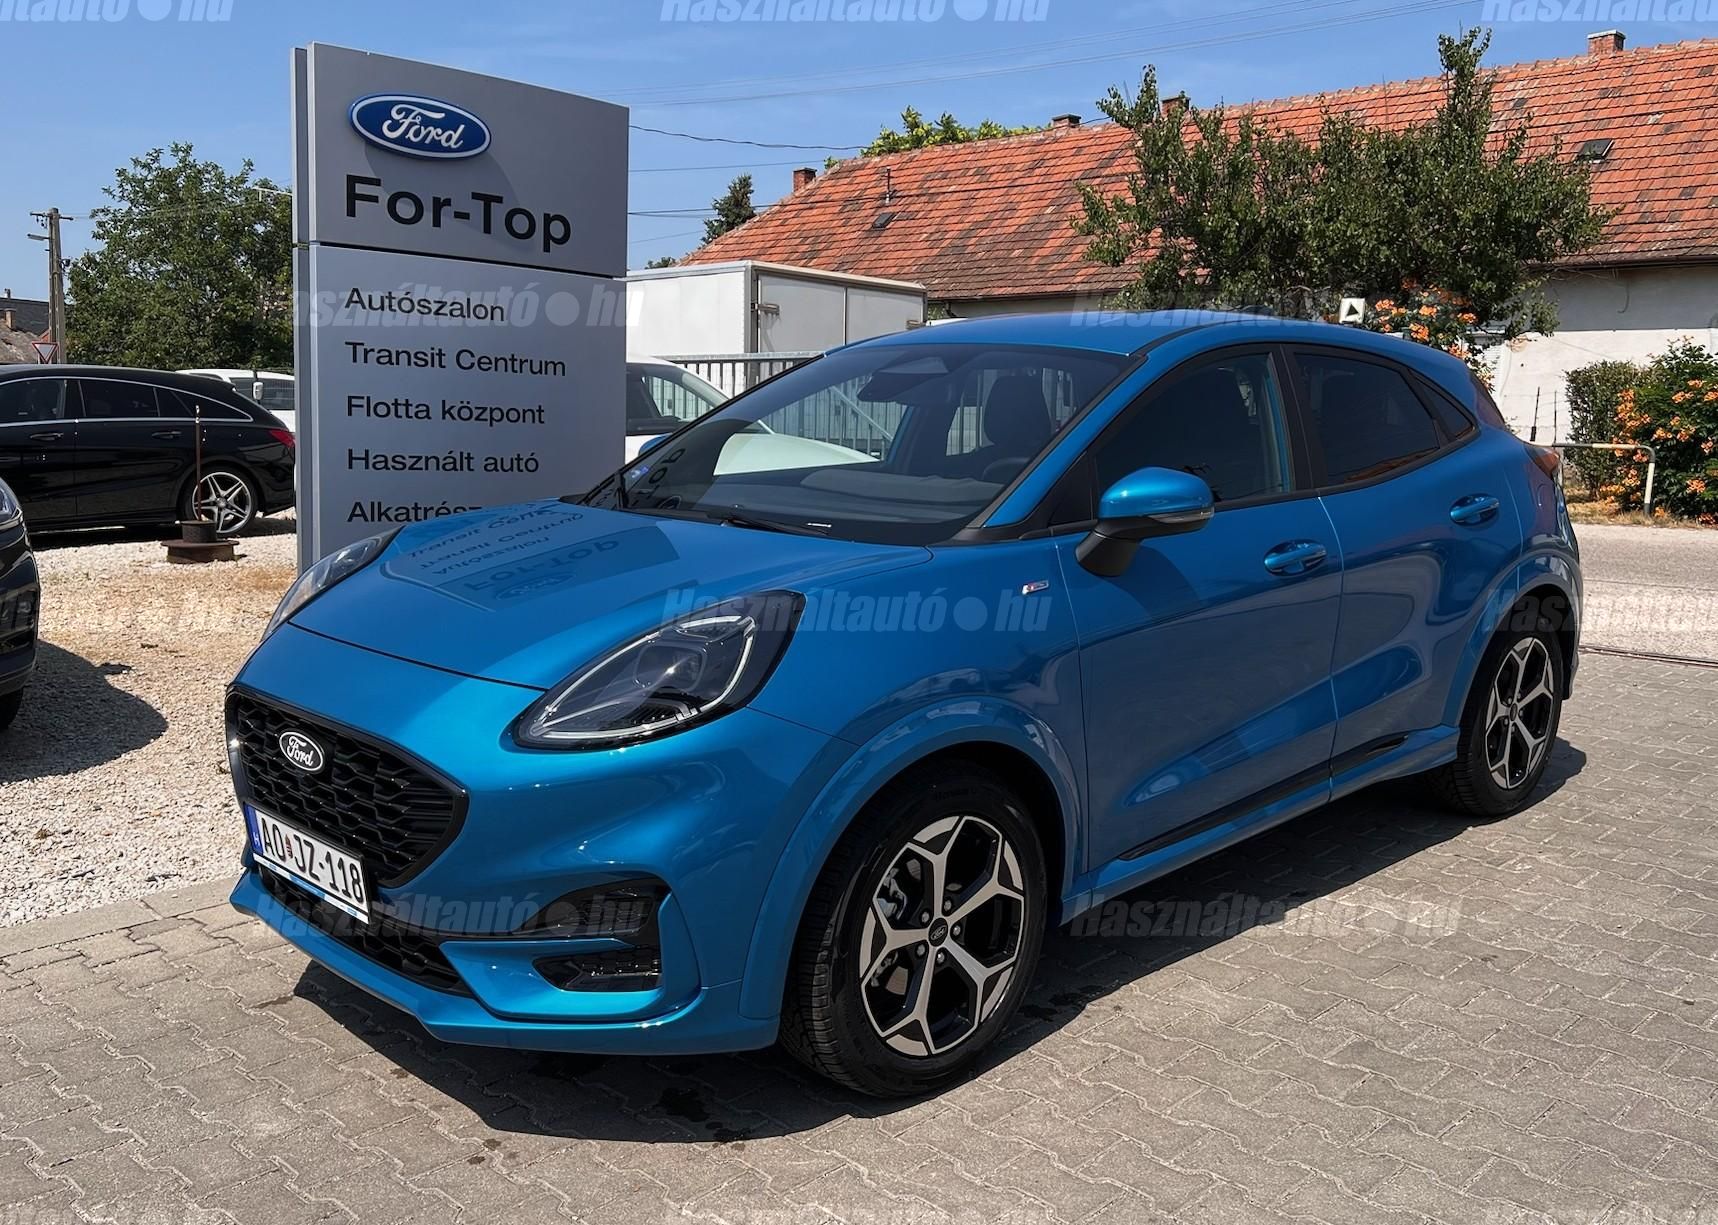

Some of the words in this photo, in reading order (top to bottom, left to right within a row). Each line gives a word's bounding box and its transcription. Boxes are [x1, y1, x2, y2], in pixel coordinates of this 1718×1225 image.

[382, 104, 466, 150] Ford
[345, 174, 572, 253] For-Top
[345, 287, 504, 322] Autószalon
[345, 341, 447, 370] Transit
[455, 348, 567, 377] Centrum
[346, 395, 432, 421] Flotta
[441, 398, 545, 428] központ
[347, 448, 475, 473] Használt
[483, 451, 540, 474] autó
[286, 735, 314, 767] Ford
